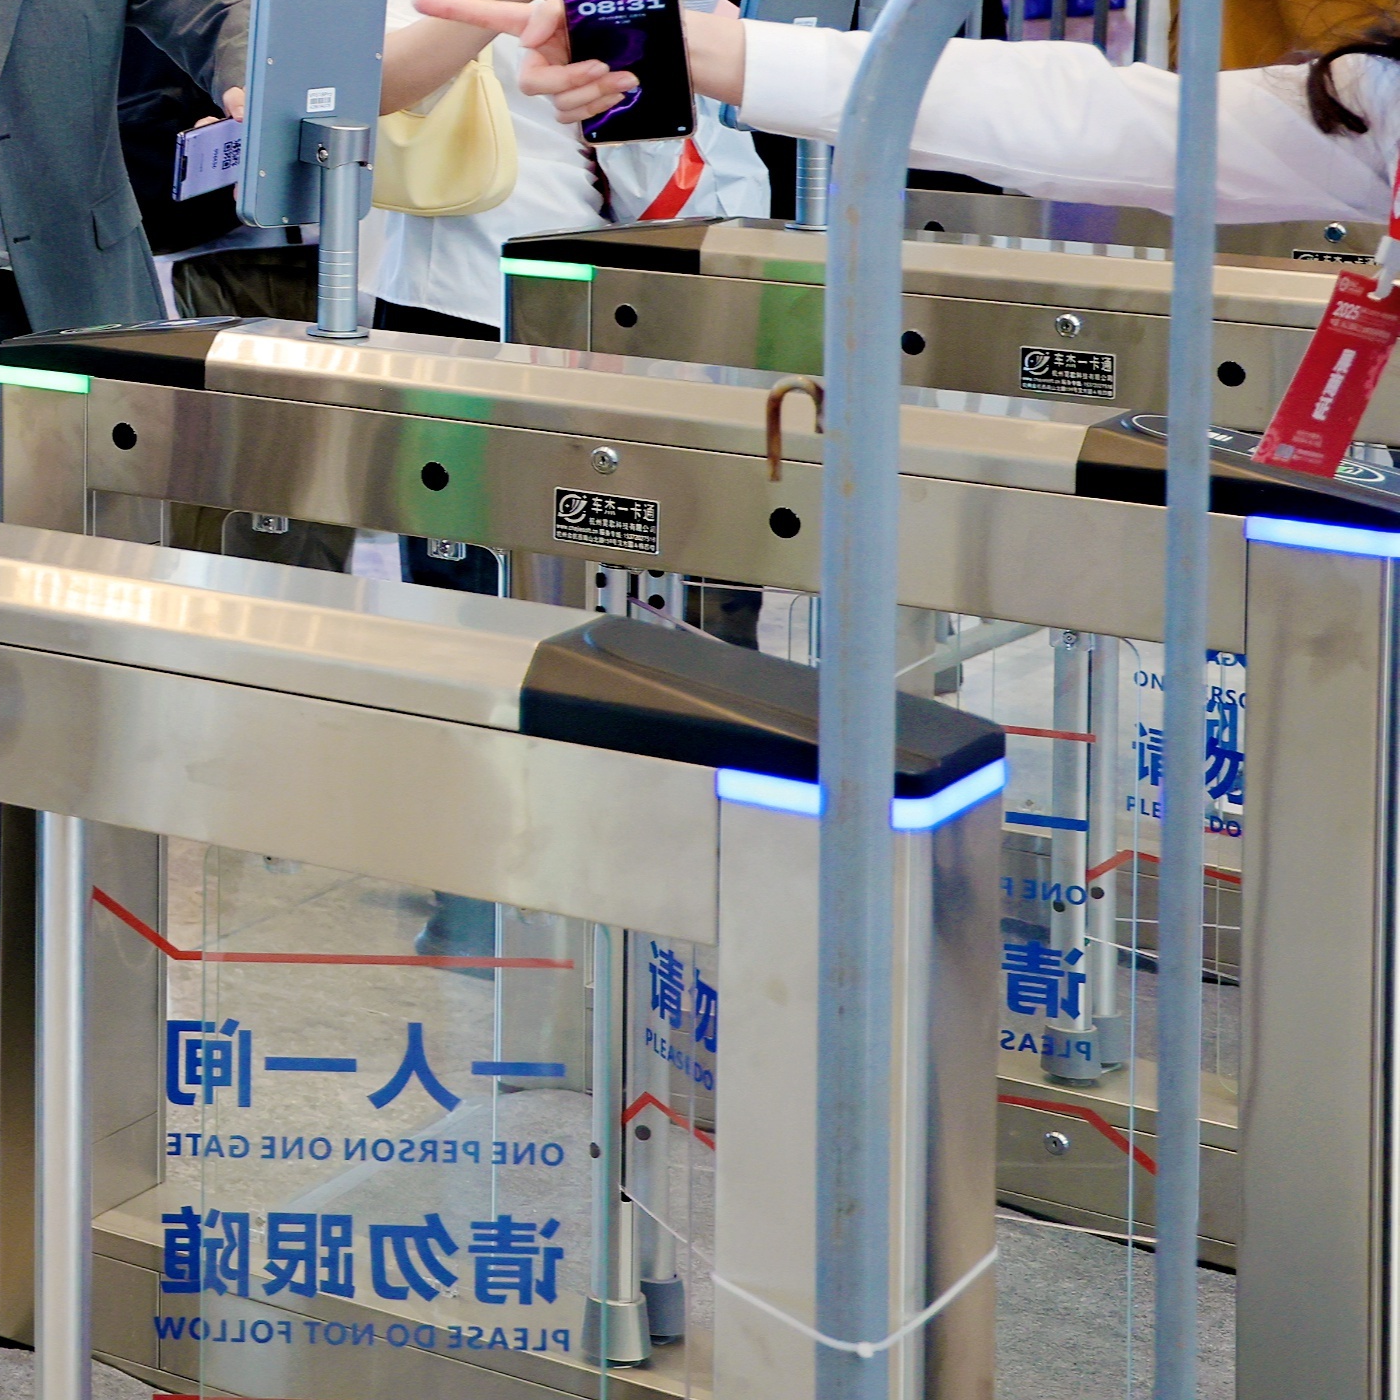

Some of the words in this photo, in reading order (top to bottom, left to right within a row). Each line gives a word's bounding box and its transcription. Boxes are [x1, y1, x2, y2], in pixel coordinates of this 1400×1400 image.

[1054, 352, 1112, 372] 车杰一卡通
[591, 496, 656, 522] 车杰一卡通
